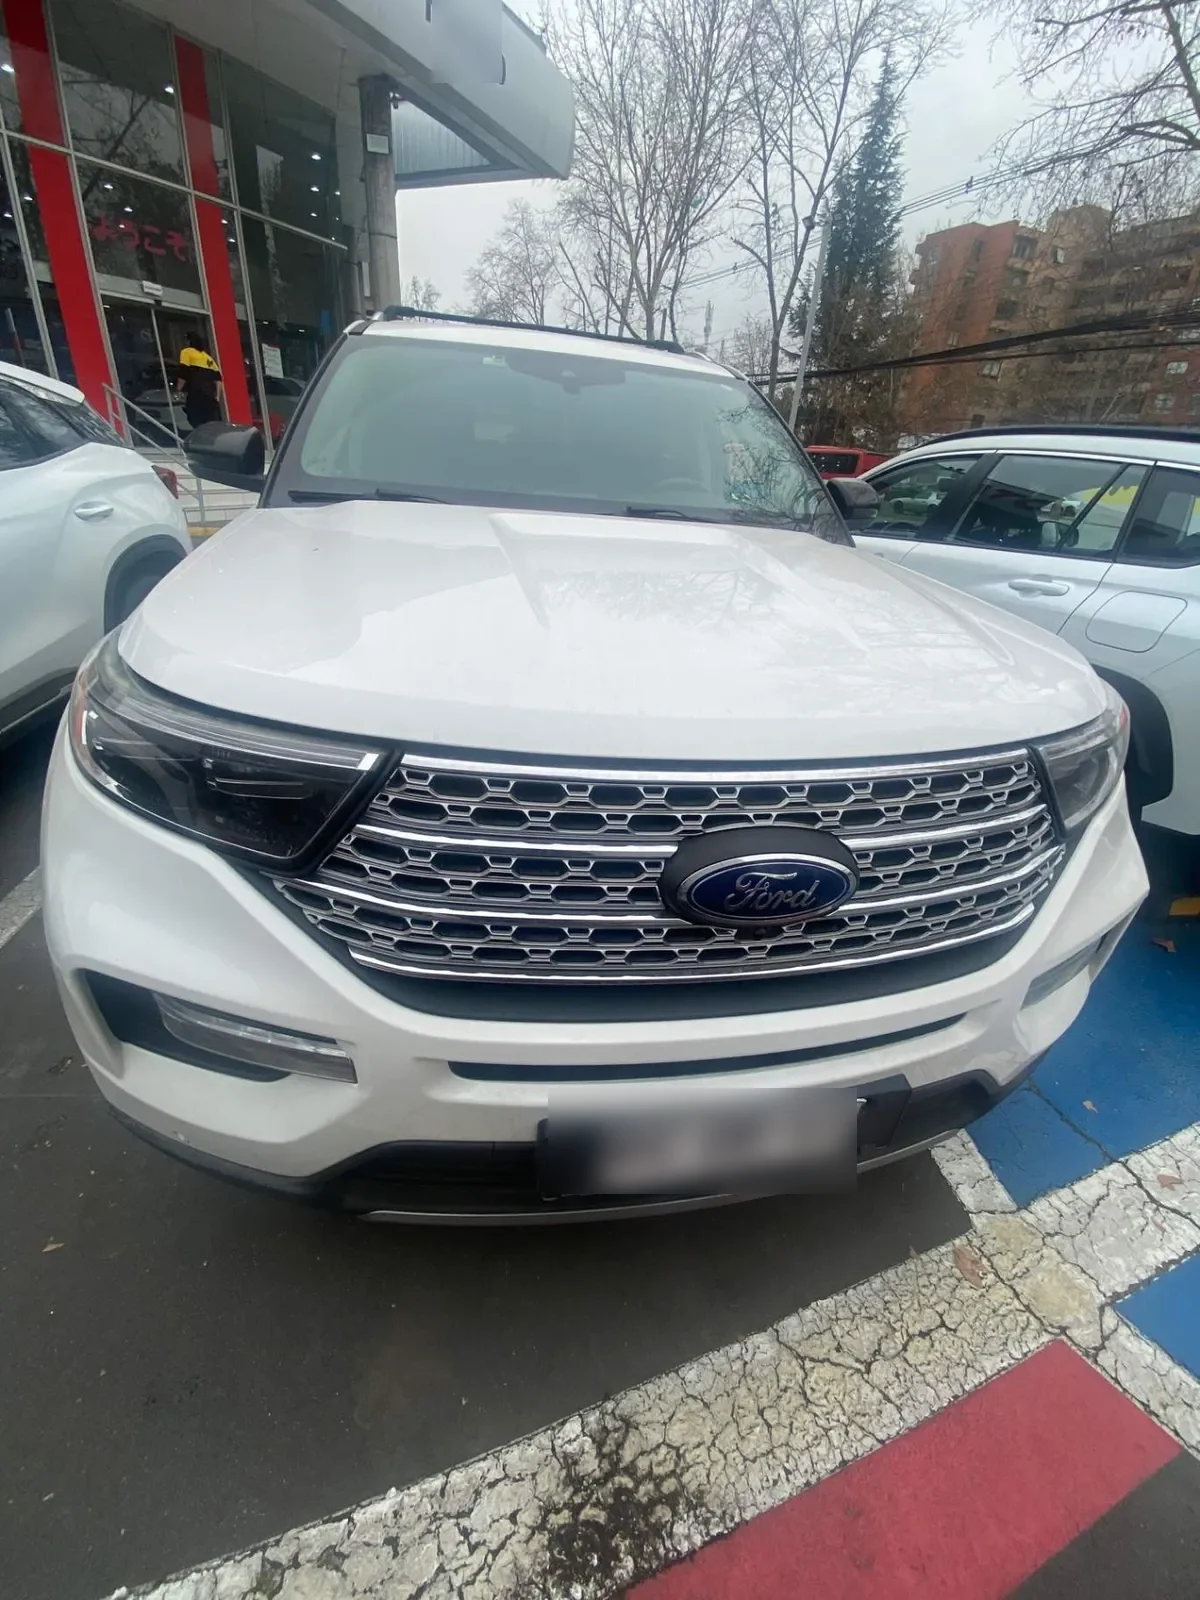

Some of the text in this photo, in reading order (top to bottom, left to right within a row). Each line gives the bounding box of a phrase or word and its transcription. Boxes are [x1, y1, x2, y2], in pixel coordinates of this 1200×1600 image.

[92, 214, 189, 262] ようこそ
[724, 872, 820, 910] Ford
